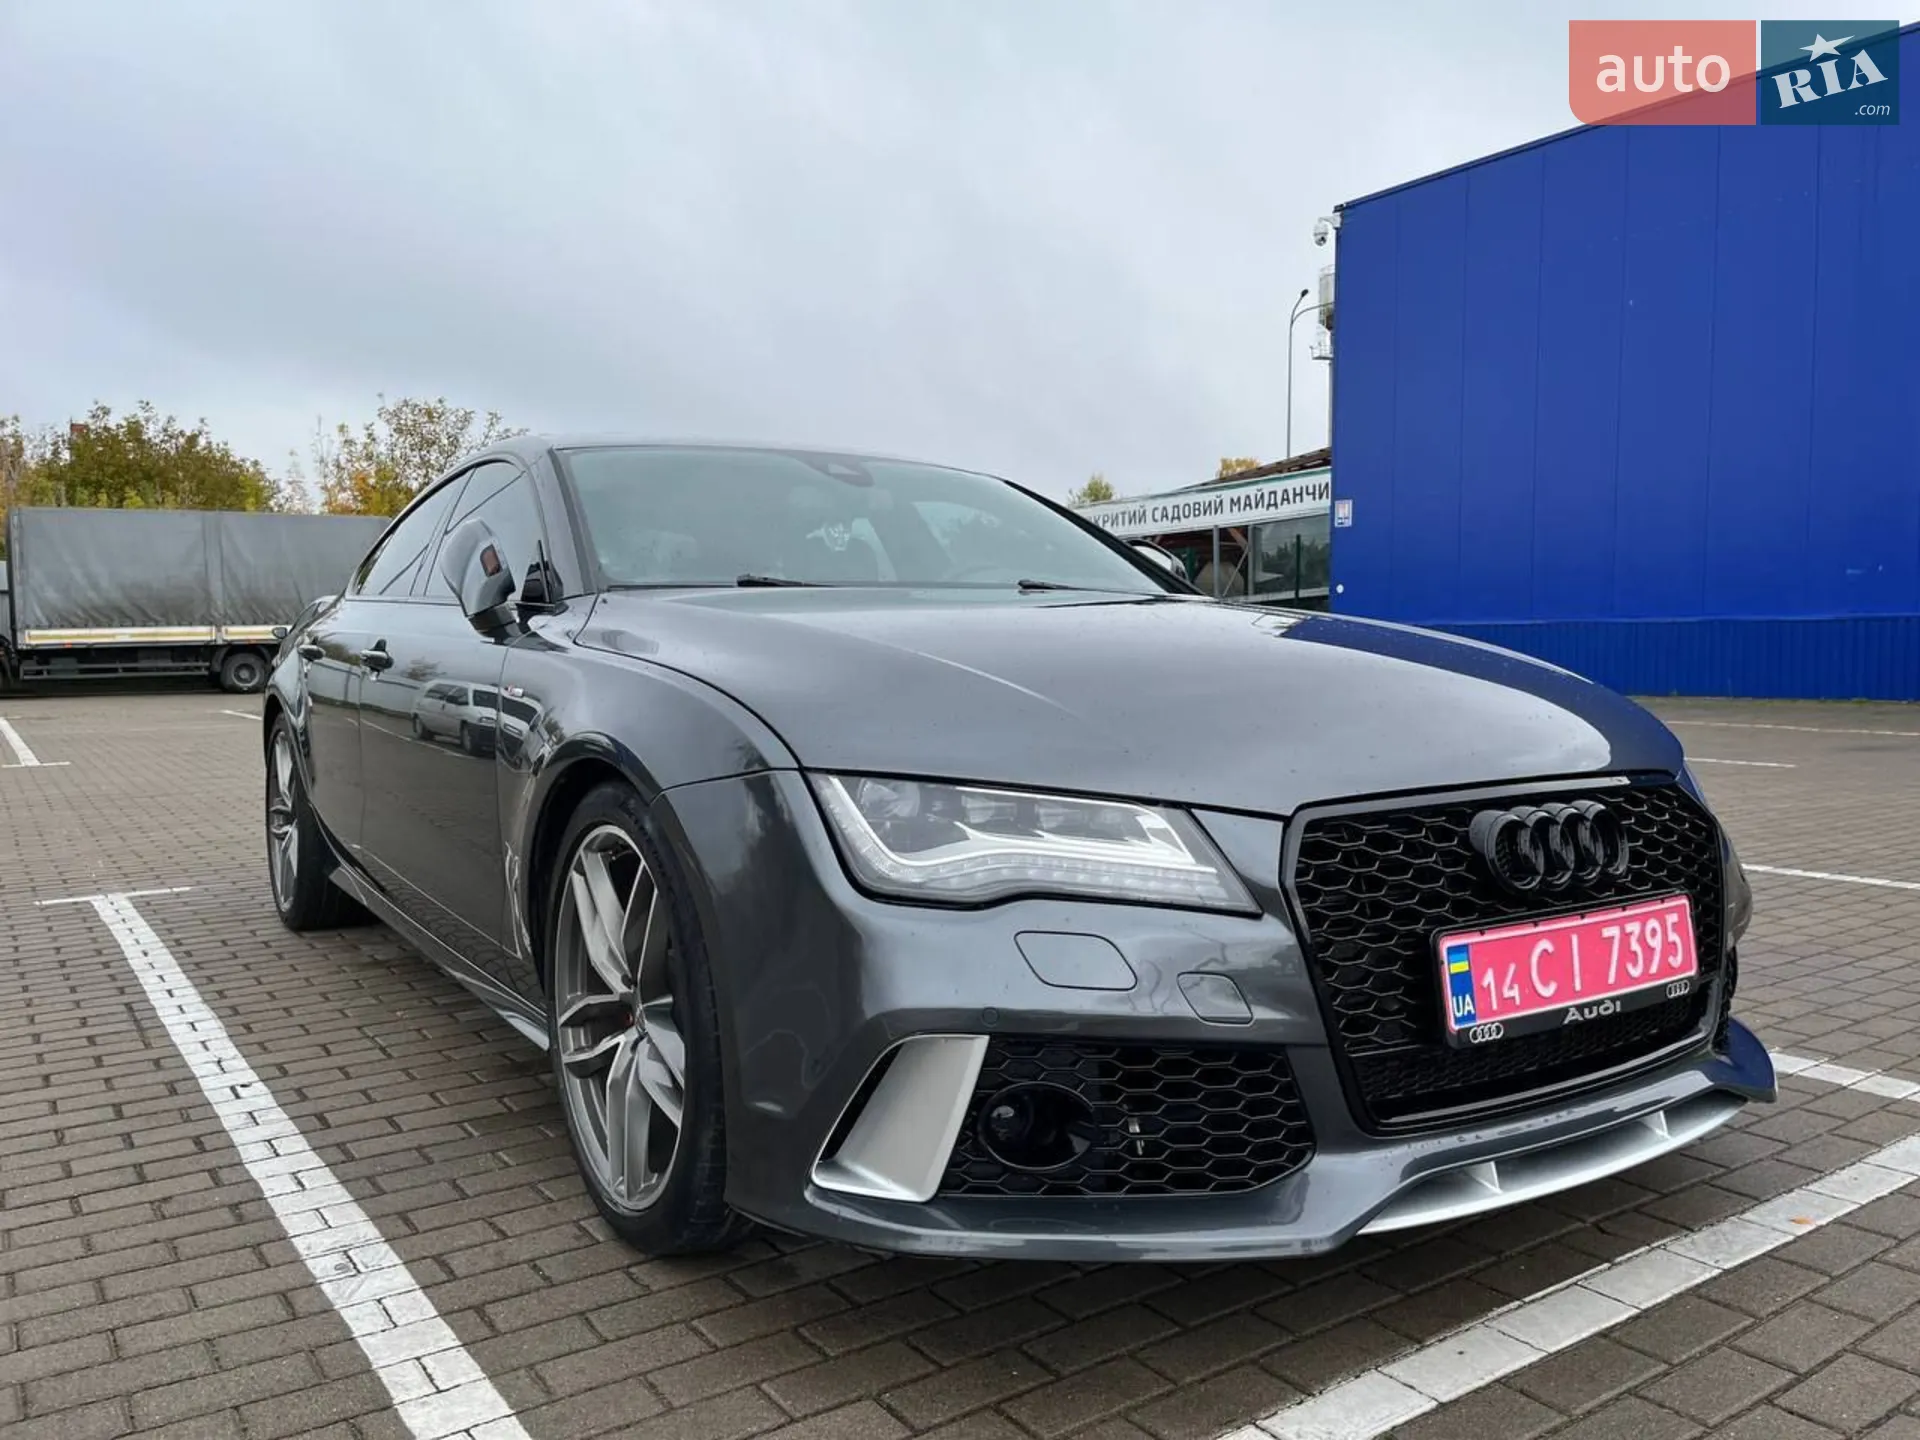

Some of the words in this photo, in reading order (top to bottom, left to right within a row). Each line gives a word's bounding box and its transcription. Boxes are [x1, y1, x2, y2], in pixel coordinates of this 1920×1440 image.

[1151, 494, 1224, 525] САДОВИЙ
[1229, 481, 1330, 512] МАЙДАНЧИ
[1480, 963, 1521, 1011] 14
[1601, 912, 1684, 985] 7395
[1453, 994, 1476, 1018] UA
[1562, 1000, 1622, 1025] Audi
